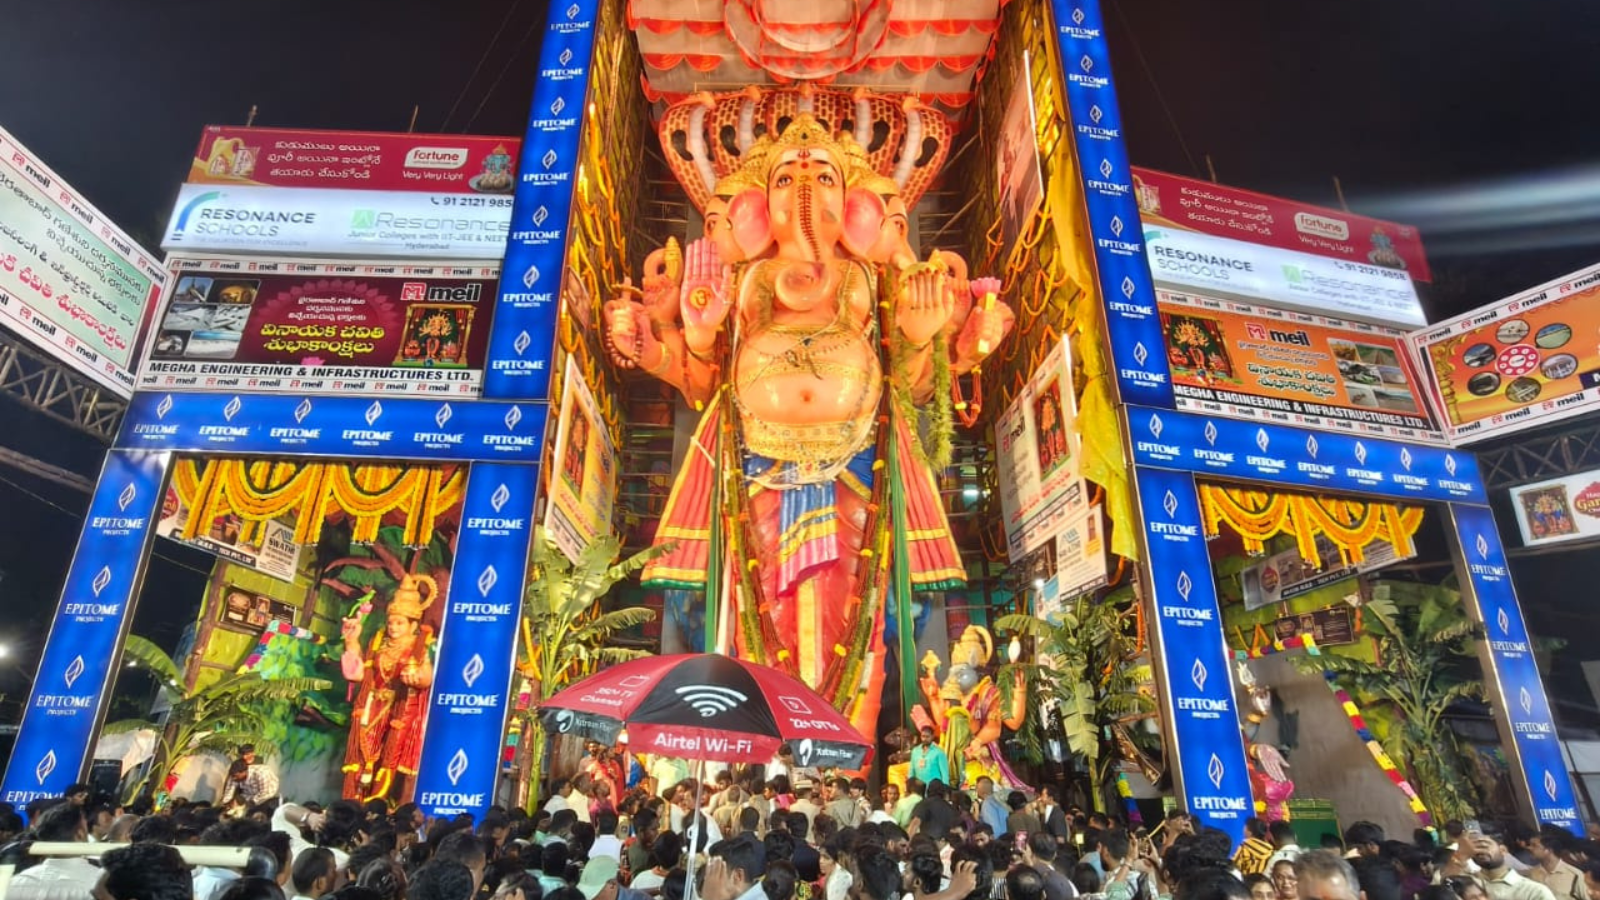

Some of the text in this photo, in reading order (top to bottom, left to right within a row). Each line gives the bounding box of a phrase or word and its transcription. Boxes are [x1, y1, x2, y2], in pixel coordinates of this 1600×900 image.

[412, 149, 460, 162] fortune
[25, 164, 51, 188] meil
[402, 170, 465, 183] Very Very Light
[443, 197, 458, 206] 91
[459, 197, 486, 207] 2121
[71, 201, 94, 224] meil
[200, 208, 317, 225] RESONANCE
[195, 222, 280, 237] SCHOOLS
[375, 212, 511, 232] Resonance
[1300, 214, 1343, 233] fortune
[513, 230, 560, 240] EPITOME
[111, 235, 131, 256] meil
[1154, 245, 1255, 272] RESONANCE
[146, 265, 165, 284] meil
[1157, 257, 1231, 280] SCHOOLS
[430, 283, 482, 302] meil
[503, 293, 552, 302] EPITOME
[32, 315, 57, 336] meil
[260, 323, 385, 339] వినాయక చవితి
[1270, 328, 1311, 347] meil
[76, 344, 98, 363] meil
[264, 338, 375, 358] శుభాకాంక్షలు
[150, 362, 474, 381] MEGHA ENGINEERING & INFRASTRUCTURES LTD.
[492, 359, 545, 370] EPITOME
[115, 369, 136, 387] meil
[1173, 384, 1429, 429] MEGHA ENGINEERING & INFRASTRUCTURES LTD.
[134, 423, 179, 434] EPITOME
[199, 425, 250, 436] EPITOME
[270, 427, 320, 438] EPITOME
[342, 429, 394, 440] EPITOME
[414, 432, 465, 443] EPITOME
[483, 434, 535, 446] EPITOME
[92, 516, 145, 529] EPITOME
[467, 518, 525, 529] EPITOME
[1150, 521, 1199, 536] EPITOME
[64, 603, 120, 616] EPITOME
[453, 602, 512, 615] EPITOME
[1163, 606, 1213, 620] EPITOME
[36, 695, 94, 708] EPITOME
[437, 693, 500, 706] EPITOME
[1178, 697, 1230, 712] EPITOME
[654, 732, 752, 753] Airtel Wi-Fi
[421, 792, 486, 807] EPITOME
[1193, 796, 1248, 810] EPITOME
